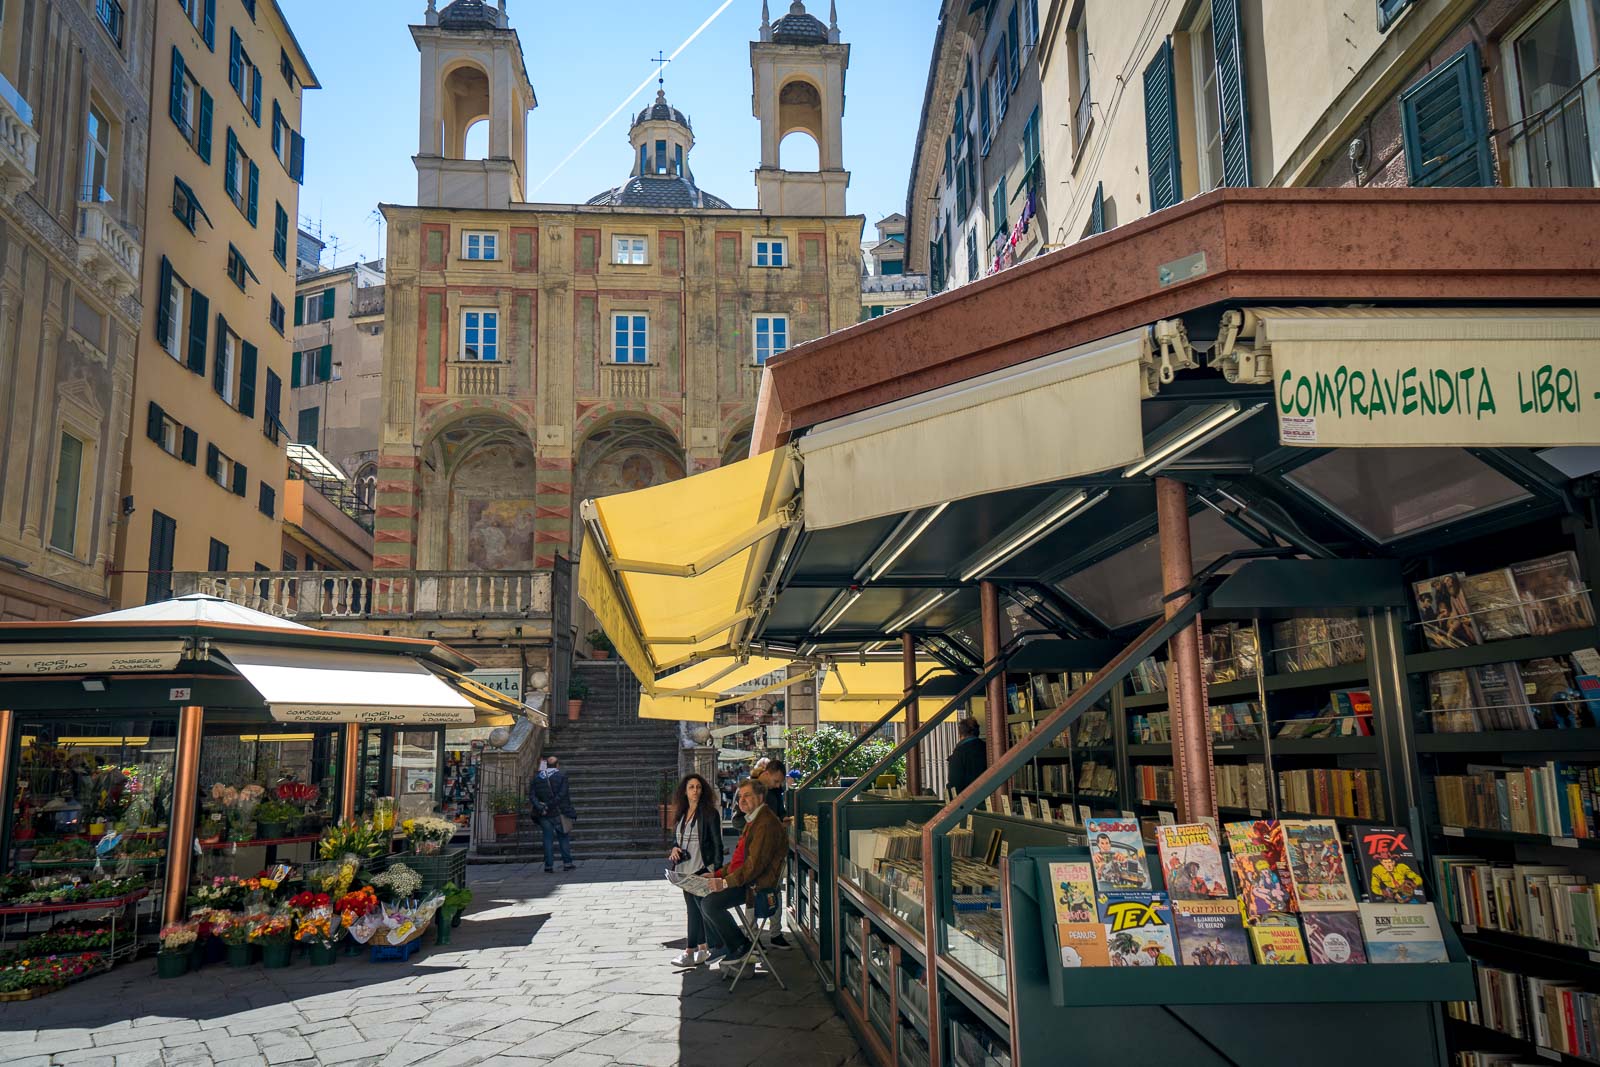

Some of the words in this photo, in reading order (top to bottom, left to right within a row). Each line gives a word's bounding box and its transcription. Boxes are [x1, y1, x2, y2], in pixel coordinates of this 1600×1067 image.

[1279, 365, 1496, 420] COMPRAVENDITA
[1518, 365, 1581, 414] LIBRI
[361, 711, 391, 719] FIORI
[1176, 825, 1208, 836] PICCOLO
[1166, 834, 1212, 847] RANGER
[1363, 834, 1409, 855] TEX
[1106, 901, 1165, 932] TEX
[1375, 916, 1391, 924] KEN
[1392, 916, 1425, 925] PARKER
